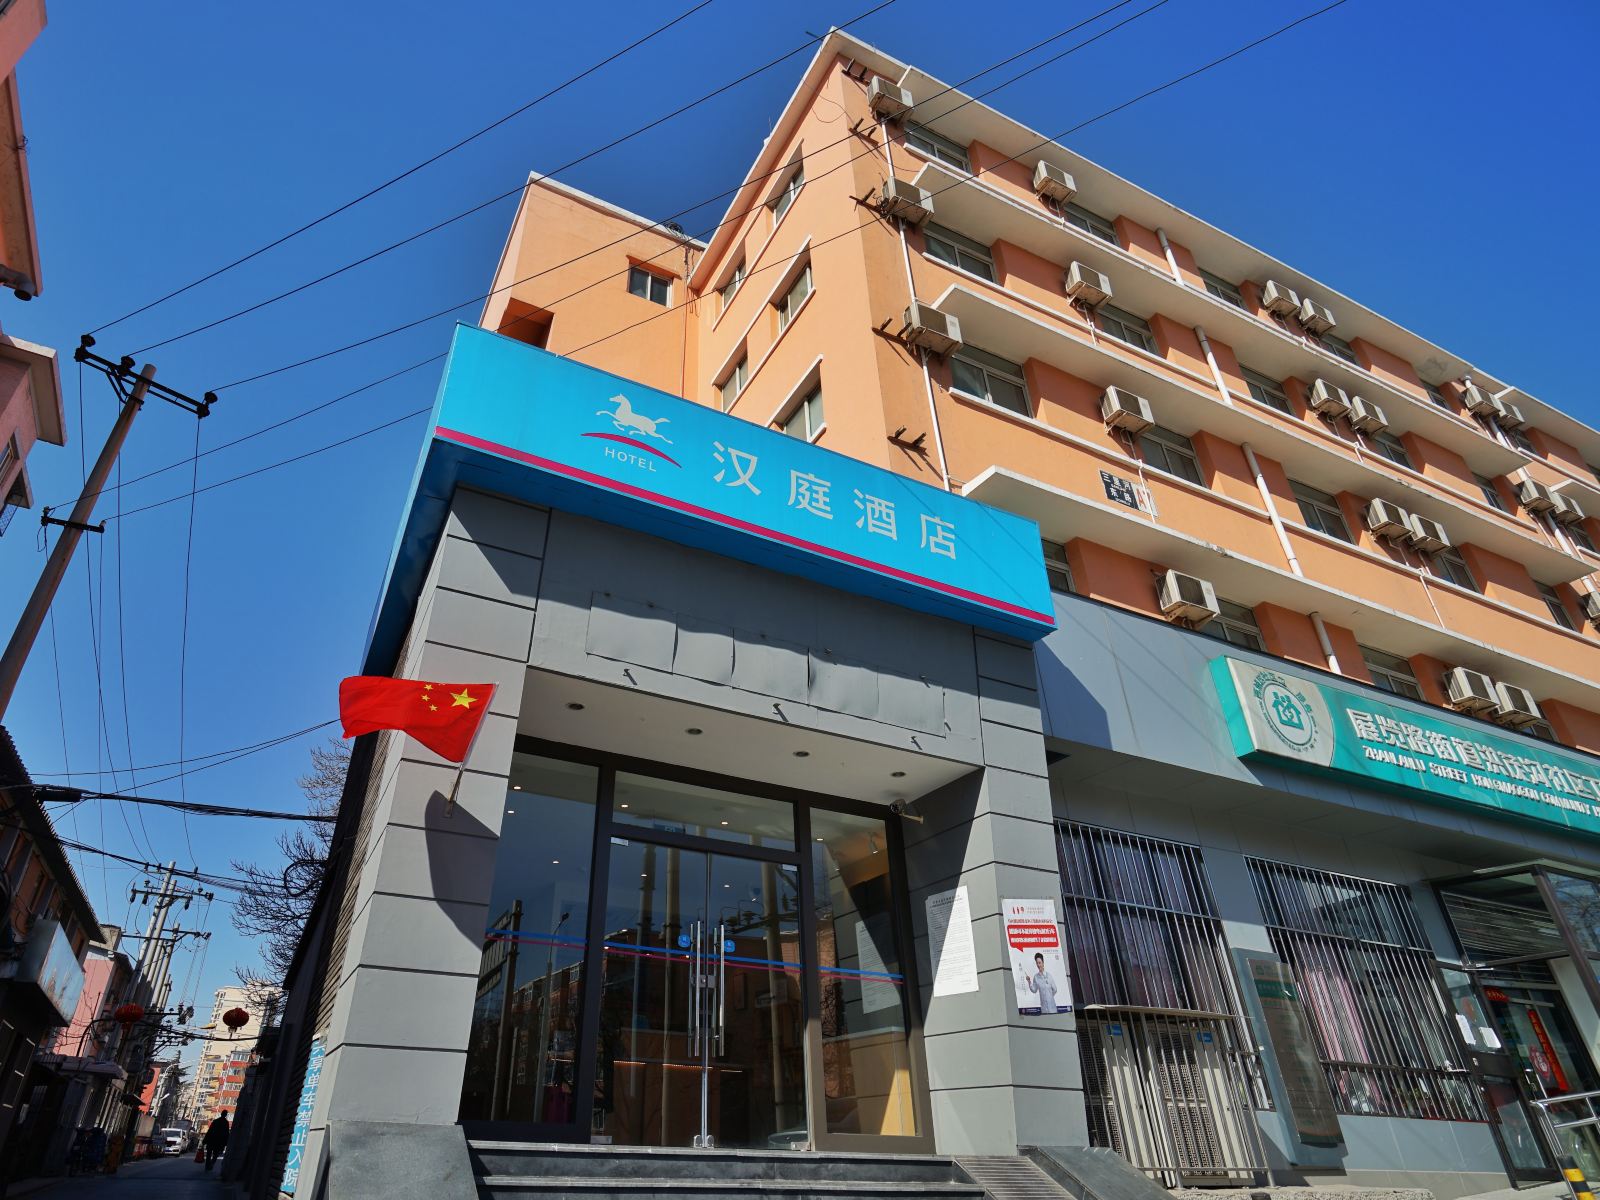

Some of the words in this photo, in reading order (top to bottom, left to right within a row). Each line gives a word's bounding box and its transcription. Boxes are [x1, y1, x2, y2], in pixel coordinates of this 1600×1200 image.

[605, 446, 657, 472] HOTEL
[712, 440, 957, 560] 汉庭酒店
[1429, 761, 1468, 784] STREET
